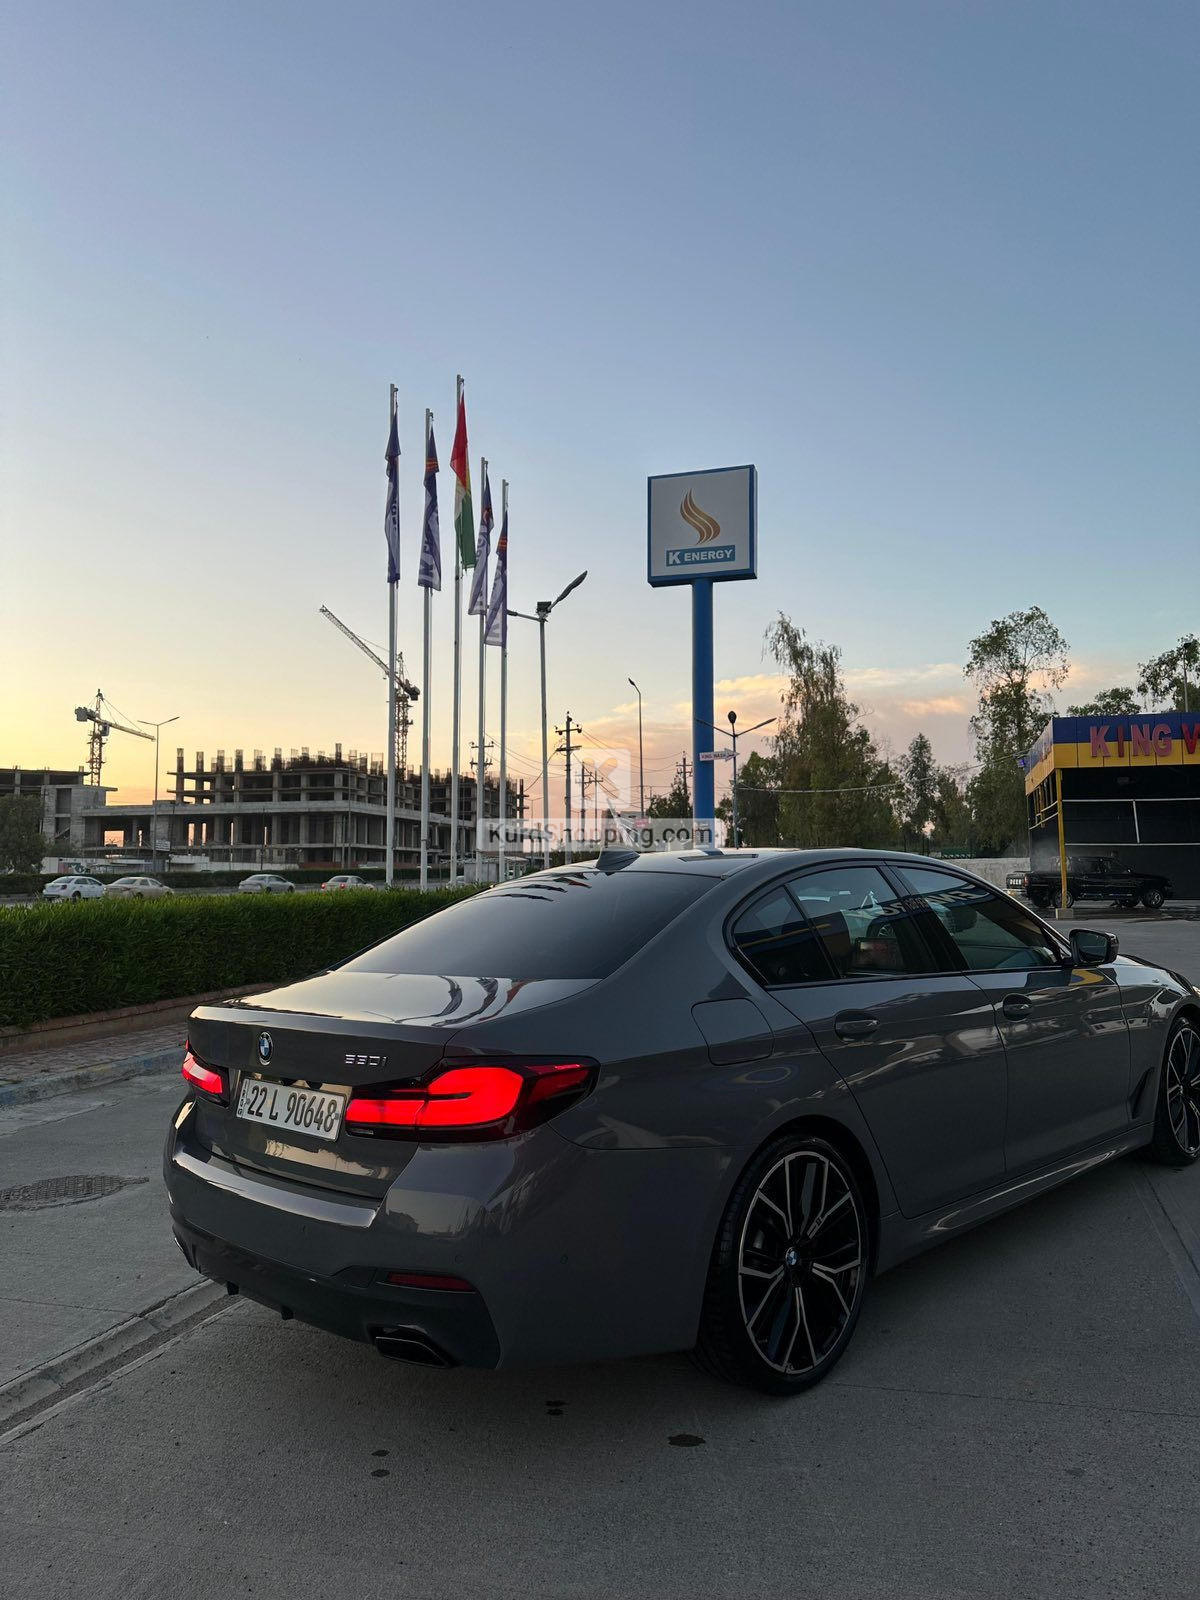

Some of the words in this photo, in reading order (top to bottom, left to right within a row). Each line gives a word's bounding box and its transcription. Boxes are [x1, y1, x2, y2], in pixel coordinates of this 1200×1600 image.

[669, 551, 681, 565] K
[684, 549, 733, 562] ENERGY
[1090, 723, 1172, 757] KING
[247, 1085, 268, 1117] 22
[269, 1089, 279, 1120] L
[284, 1092, 338, 1132] 90648
